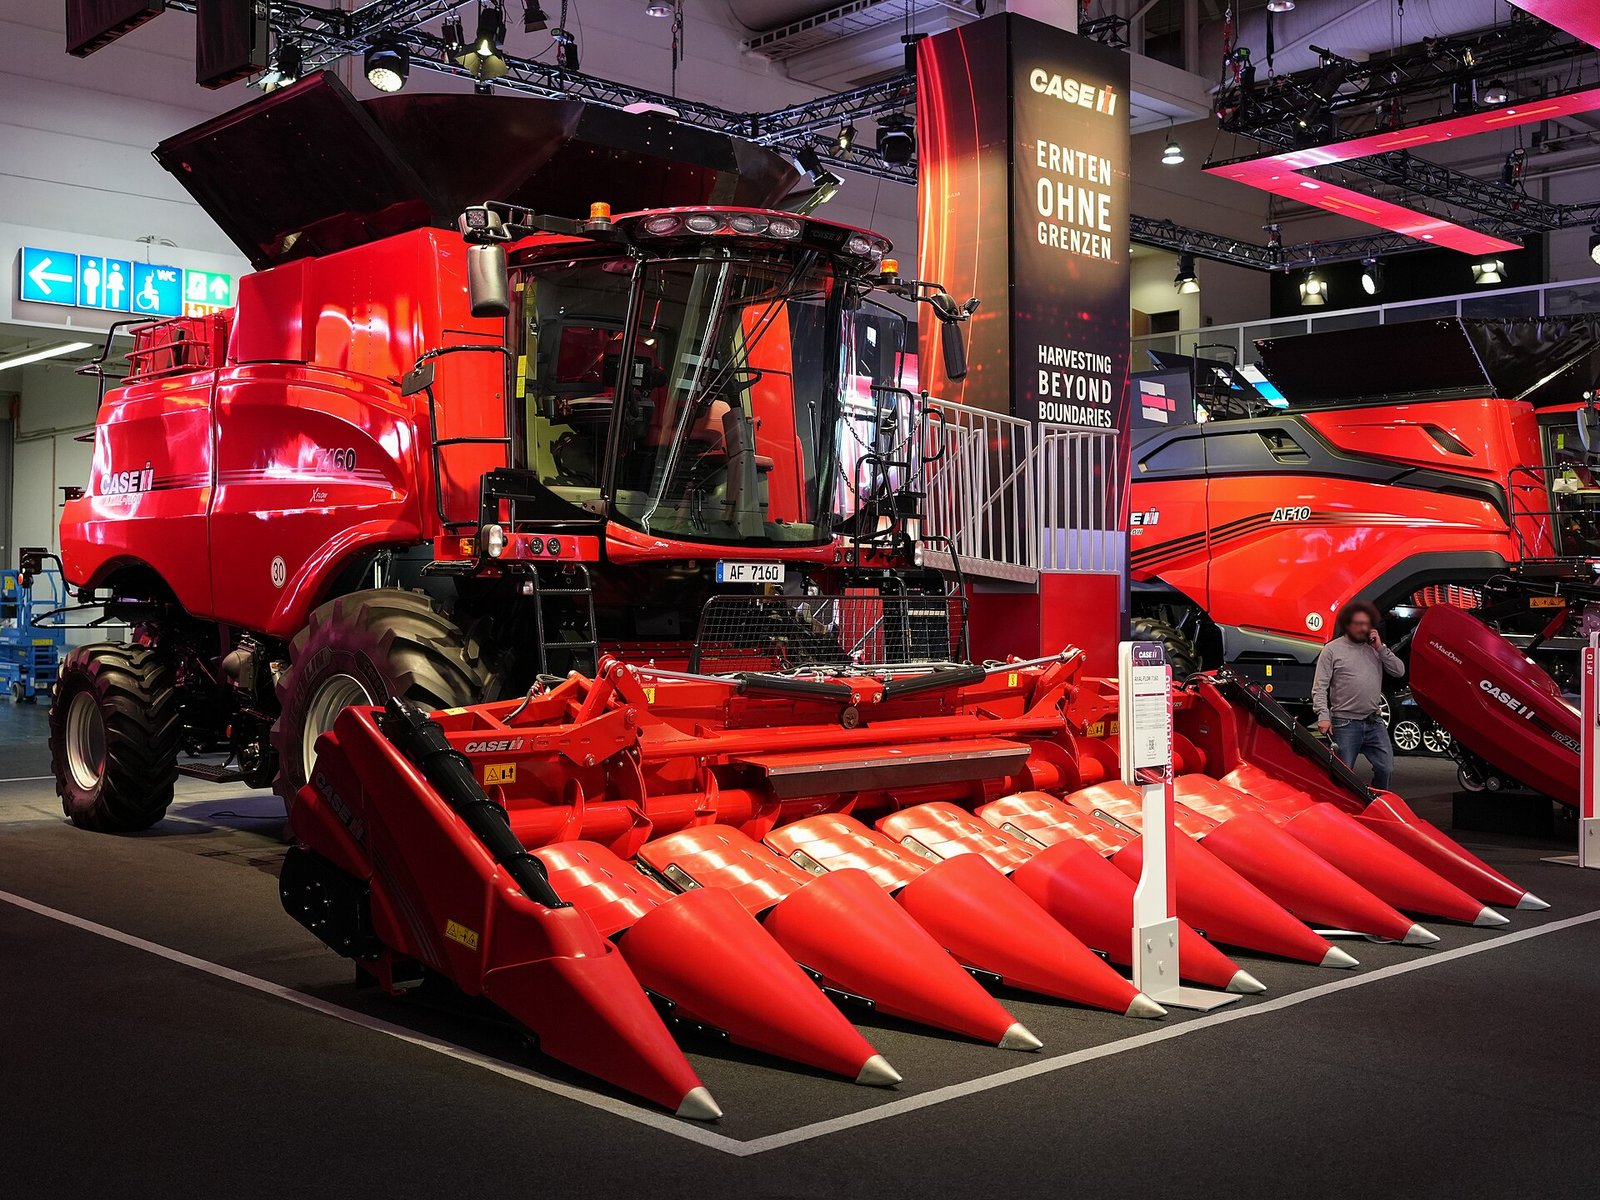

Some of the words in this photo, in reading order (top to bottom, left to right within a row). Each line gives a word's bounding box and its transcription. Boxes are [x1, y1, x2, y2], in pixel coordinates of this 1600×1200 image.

[1029, 68, 1096, 109] CASE
[1037, 139, 1111, 186] ERNTEN
[1037, 177, 1111, 232] OHNE
[1037, 221, 1111, 260] GRENZEN
[157, 269, 176, 283] WC
[1038, 345, 1112, 375] HARVESTING
[1038, 369, 1112, 404] BEYOND
[1038, 401, 1112, 428] BOUNDARIES
[315, 447, 357, 473] 7160
[100, 471, 140, 495] CASE
[1271, 506, 1311, 522] AF10
[273, 562, 284, 582] 30
[730, 565, 745, 580] AF
[751, 565, 779, 580] 7160
[1307, 616, 1320, 628] 40
[1479, 679, 1521, 710] CASE
[465, 740, 509, 753] CASE
[315, 771, 352, 824] CASE
